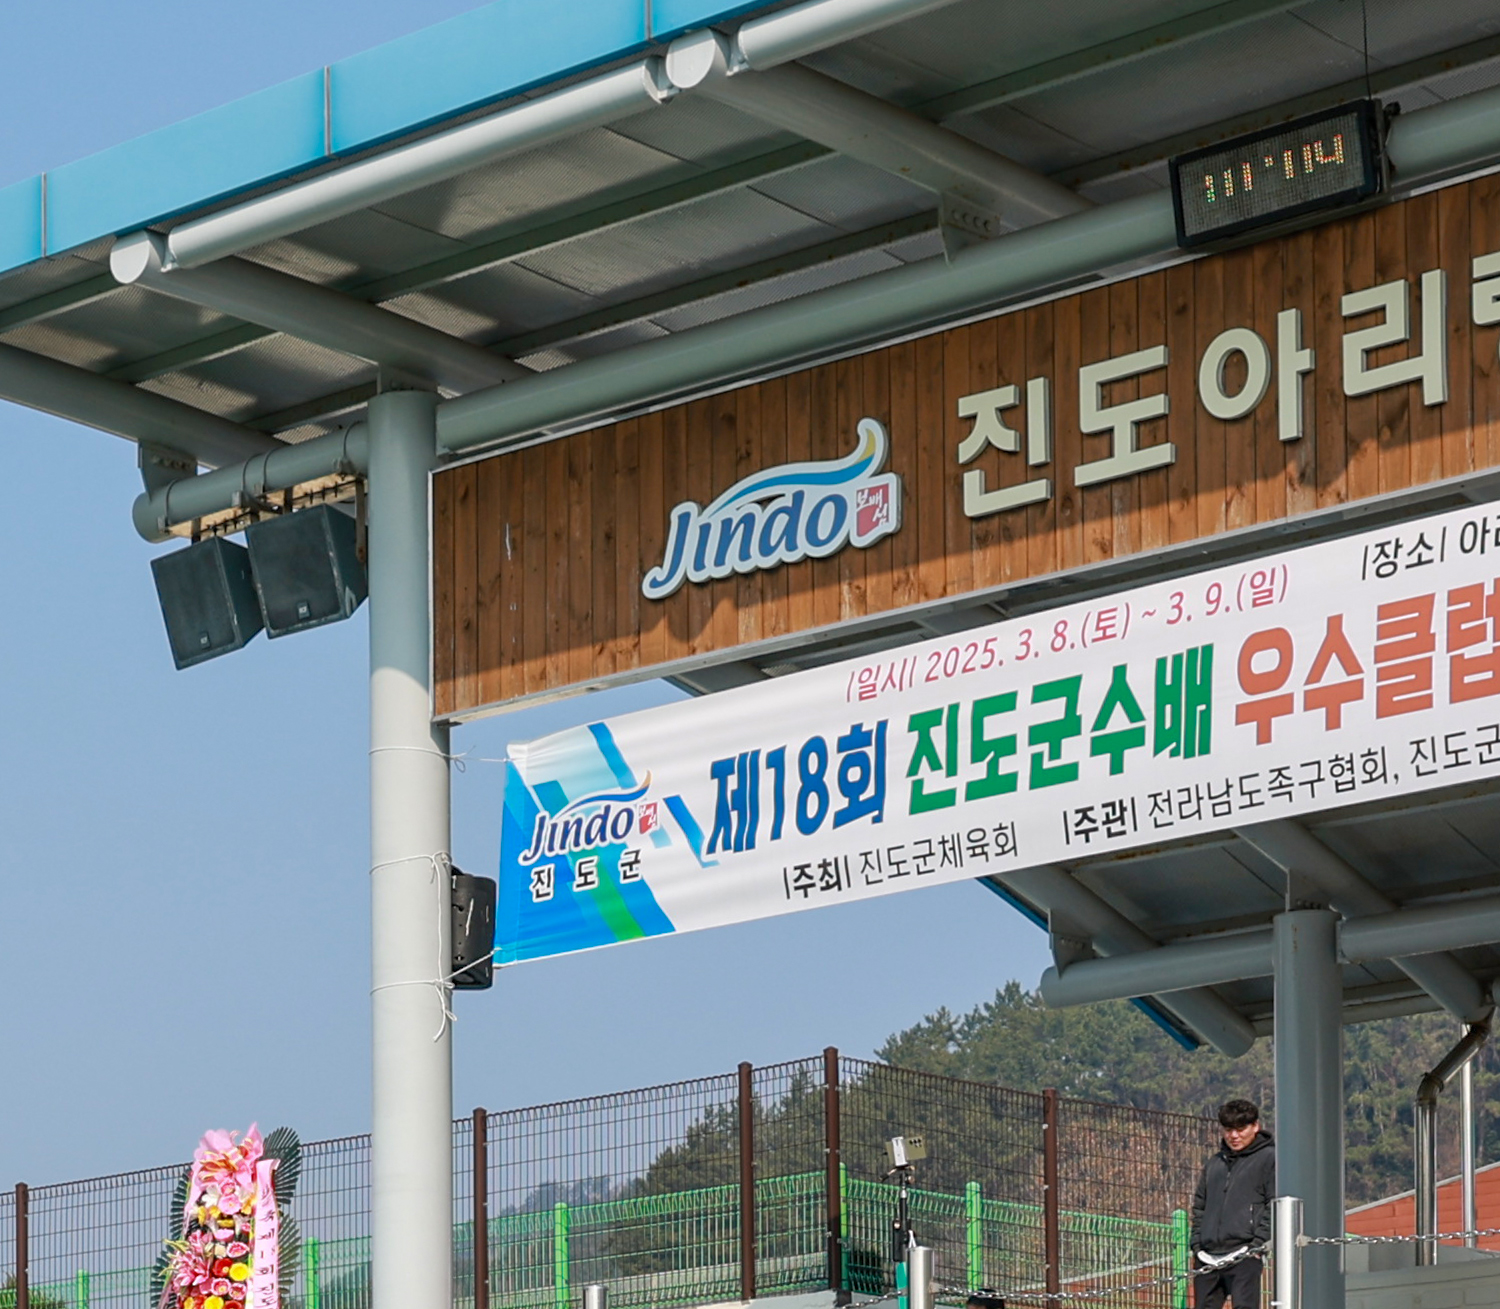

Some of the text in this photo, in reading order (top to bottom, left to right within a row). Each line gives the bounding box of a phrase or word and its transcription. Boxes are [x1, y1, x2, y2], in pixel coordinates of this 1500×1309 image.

[648, 488, 850, 590] Jindo
[705, 719, 889, 855] 제18회
[905, 643, 1214, 815] 진도군수배
[522, 804, 634, 862] Jindo
[859, 821, 1019, 885] 진도군체육회
